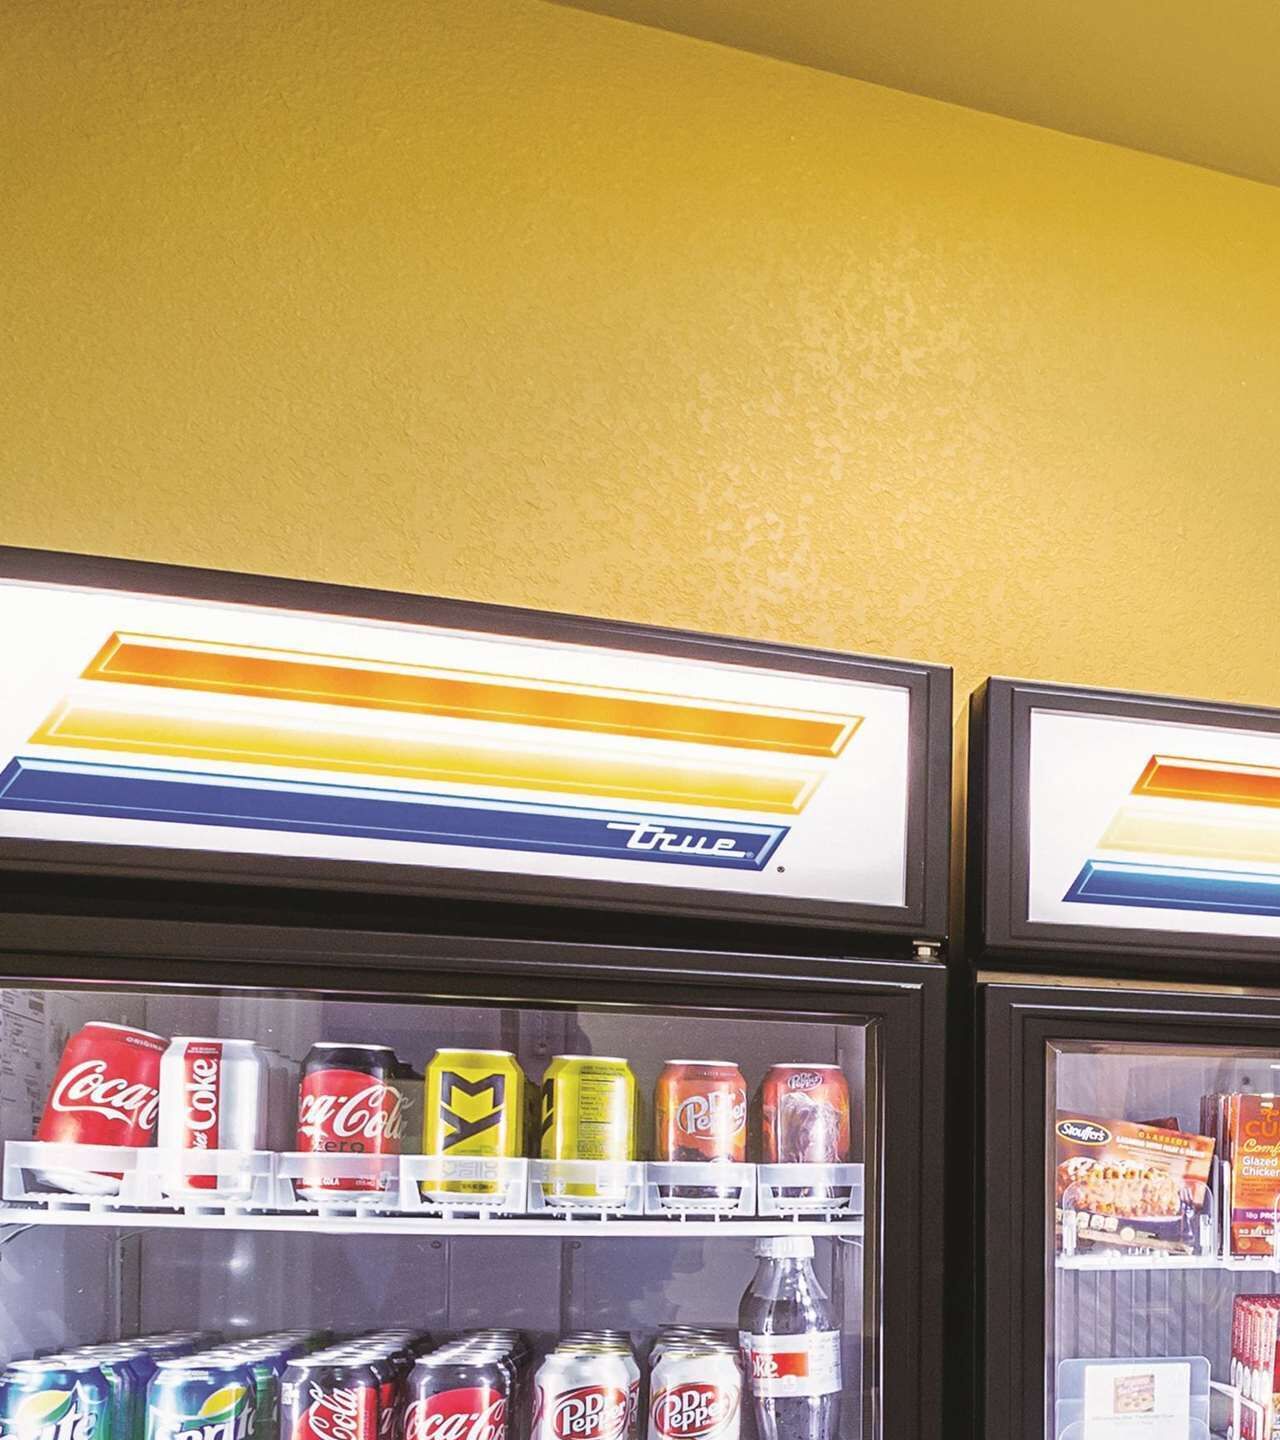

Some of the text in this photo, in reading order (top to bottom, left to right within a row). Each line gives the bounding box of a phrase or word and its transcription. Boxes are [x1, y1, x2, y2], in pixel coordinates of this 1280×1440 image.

[186, 1057, 218, 1130] Coke
[1060, 1122, 1107, 1144] Stouffer's
[1242, 1156, 1279, 1167] Glazed
[681, 1388, 712, 1410] Dr
